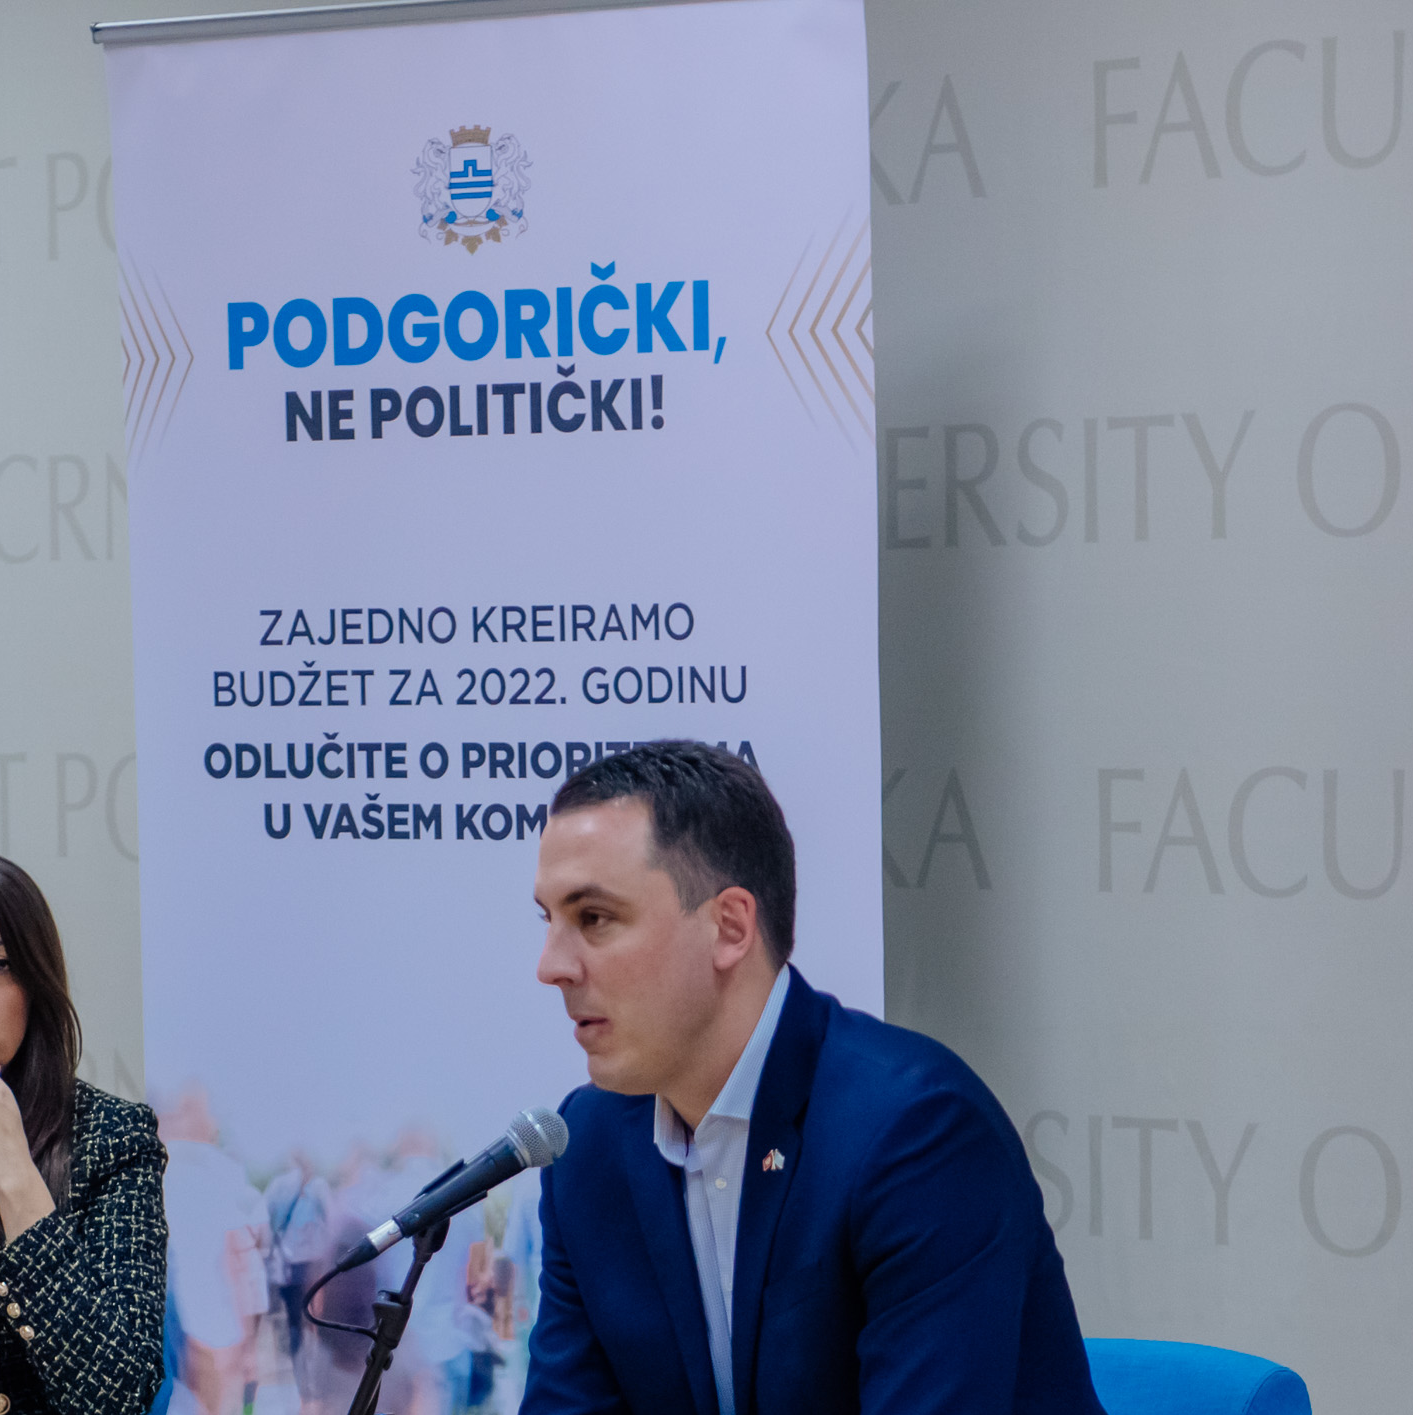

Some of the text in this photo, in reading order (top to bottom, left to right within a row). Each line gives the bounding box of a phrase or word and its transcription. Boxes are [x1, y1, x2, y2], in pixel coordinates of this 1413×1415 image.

[227, 261, 727, 370] PODGORIČKI,
[285, 363, 665, 442] NE POLITIČKI!
[884, 408, 1258, 551] ERSITY
[260, 602, 695, 647] ZAJEDNO KREIRAMO
[213, 660, 748, 708] BUDŽET ZA 2022. GODINU
[204, 732, 407, 780] ODLUČITE
[419, 741, 449, 780] O
[263, 802, 292, 840] U
[303, 792, 443, 841] VAŠEM
